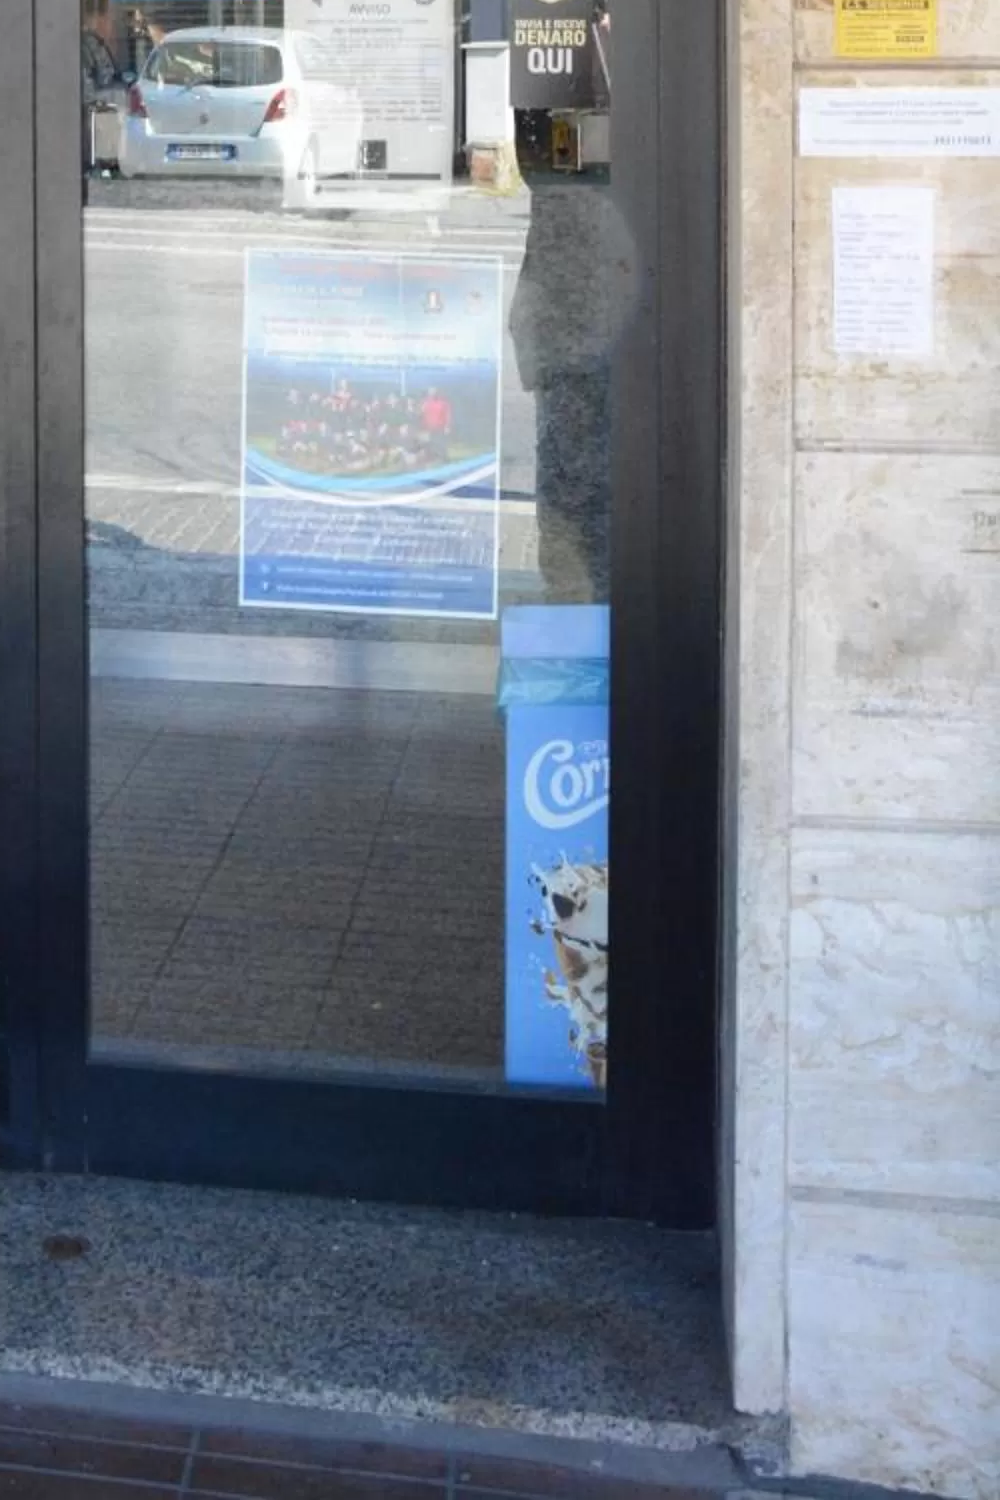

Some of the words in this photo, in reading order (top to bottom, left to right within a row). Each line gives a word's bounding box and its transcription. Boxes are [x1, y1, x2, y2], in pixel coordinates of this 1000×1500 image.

[350, 3, 391, 15] AVVISO
[514, 28, 587, 46] DENARO
[527, 46, 574, 75] QUI
